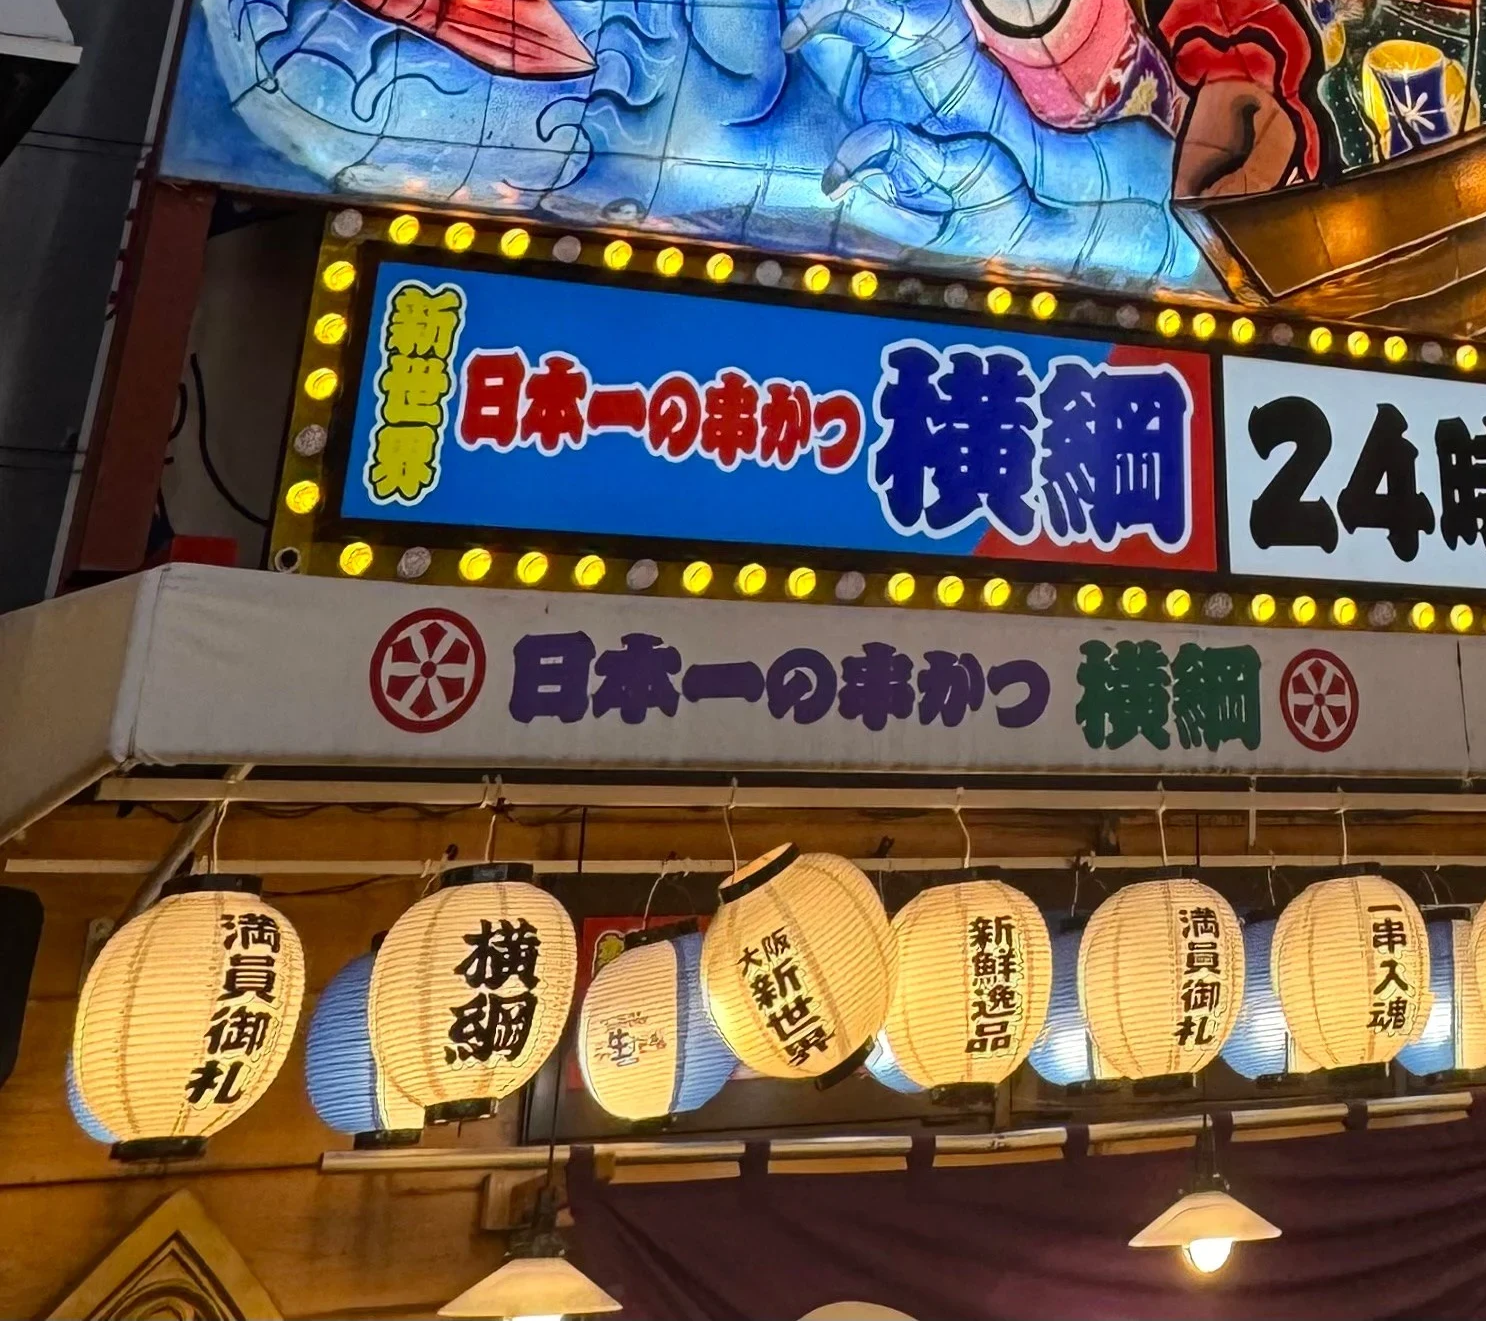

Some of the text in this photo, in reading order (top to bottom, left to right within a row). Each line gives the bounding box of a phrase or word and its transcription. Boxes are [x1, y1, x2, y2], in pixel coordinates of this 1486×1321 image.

[369, 284, 463, 501] 新世界
[460, 345, 1190, 546] 日本一の串かつ 横綱
[509, 630, 1262, 752] 日本一の串かつ 横綱
[443, 916, 542, 1067] 横綱
[750, 958, 836, 1068] 新世界
[966, 914, 1018, 1054] 新鮮逸品
[1367, 904, 1410, 1030] 一串入魂
